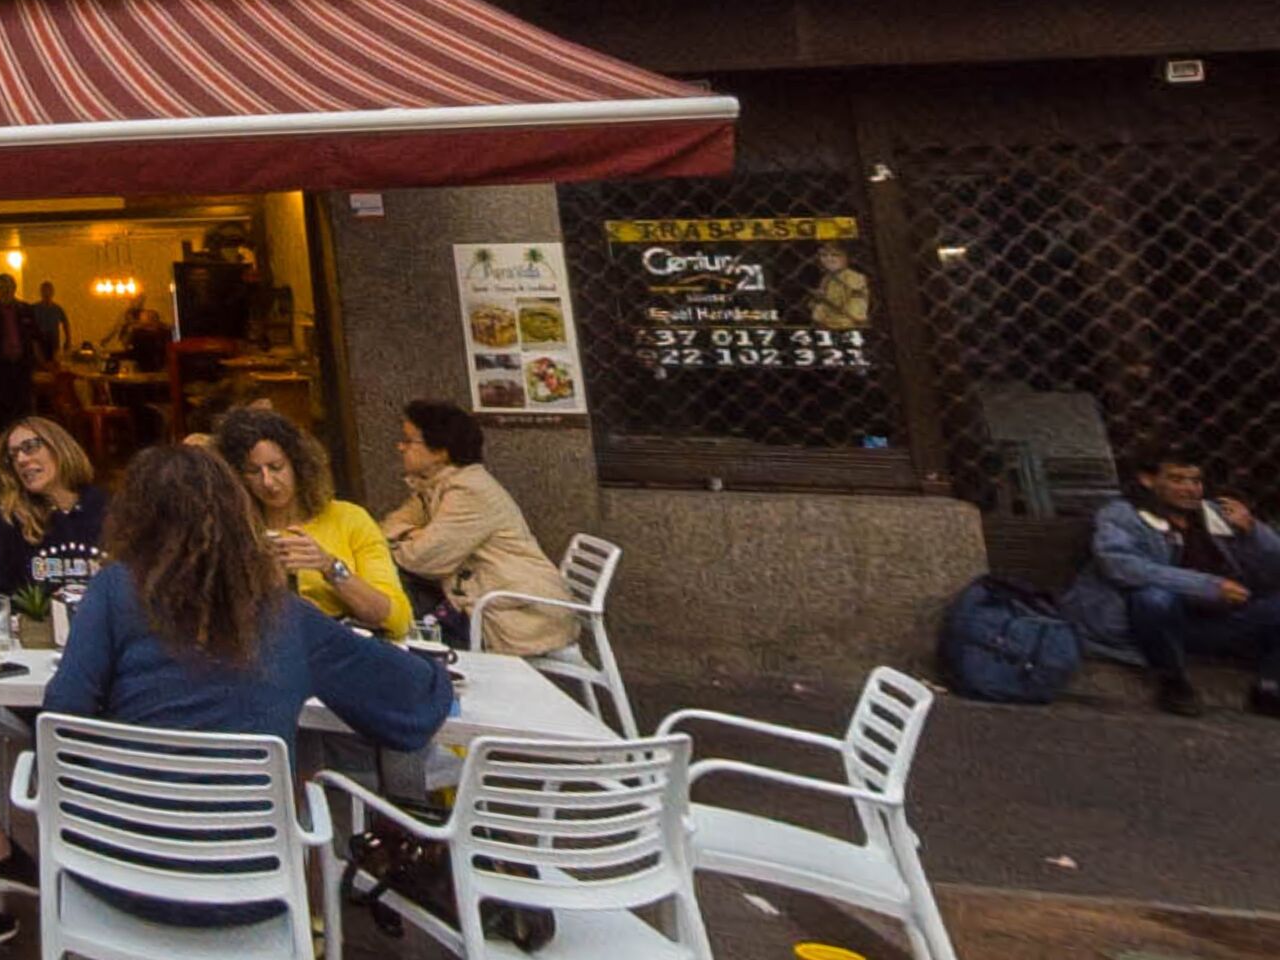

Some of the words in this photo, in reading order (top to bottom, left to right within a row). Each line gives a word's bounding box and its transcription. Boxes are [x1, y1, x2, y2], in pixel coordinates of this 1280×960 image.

[641, 220, 817, 240] TRASPASO
[711, 329, 776, 347] 017
[716, 348, 783, 367] 102
